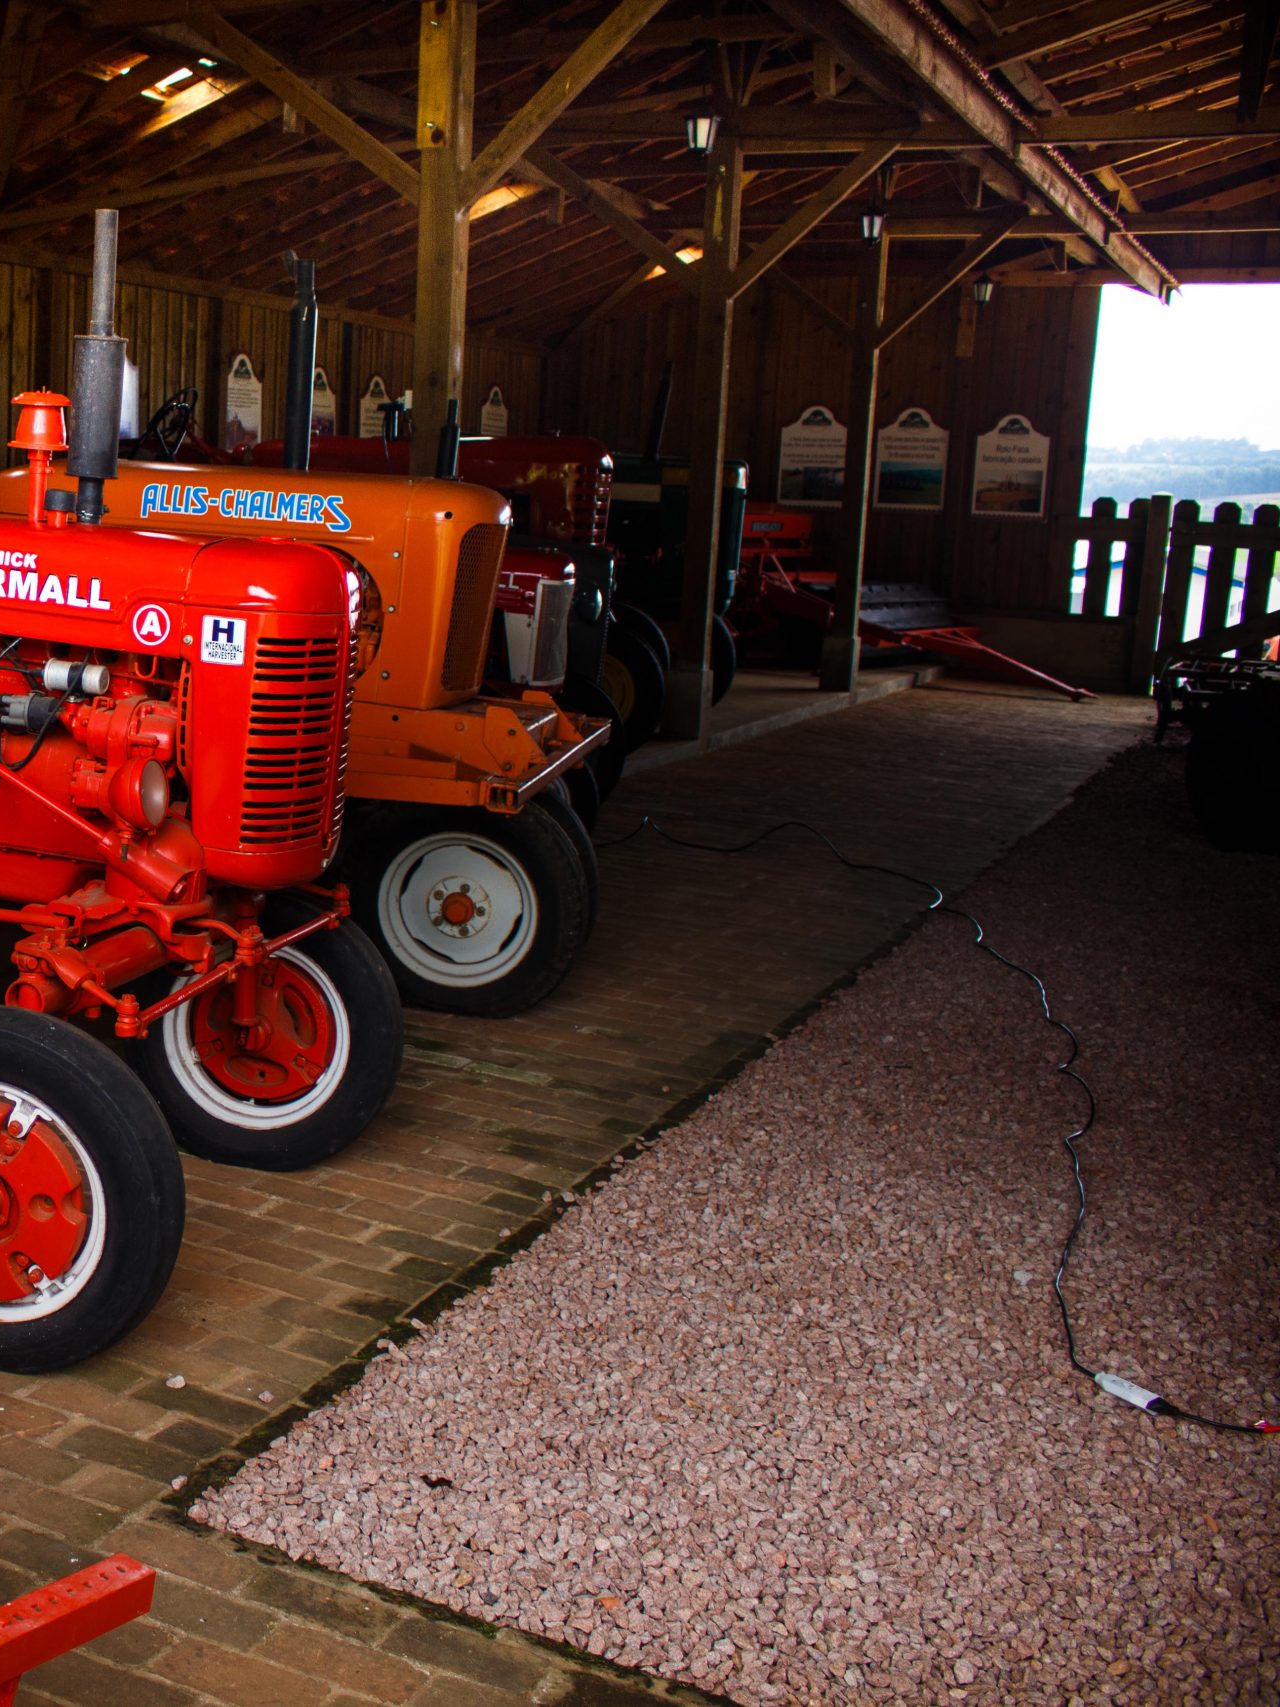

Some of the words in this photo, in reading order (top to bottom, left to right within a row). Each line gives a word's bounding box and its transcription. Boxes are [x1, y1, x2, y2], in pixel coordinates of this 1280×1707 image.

[140, 483, 351, 532] ALLIS-CHALMERS
[139, 610, 163, 637] A
[212, 619, 235, 643] H
[204, 641, 243, 653] INTERNACIONAL
[208, 650, 237, 660] HARVESTER
